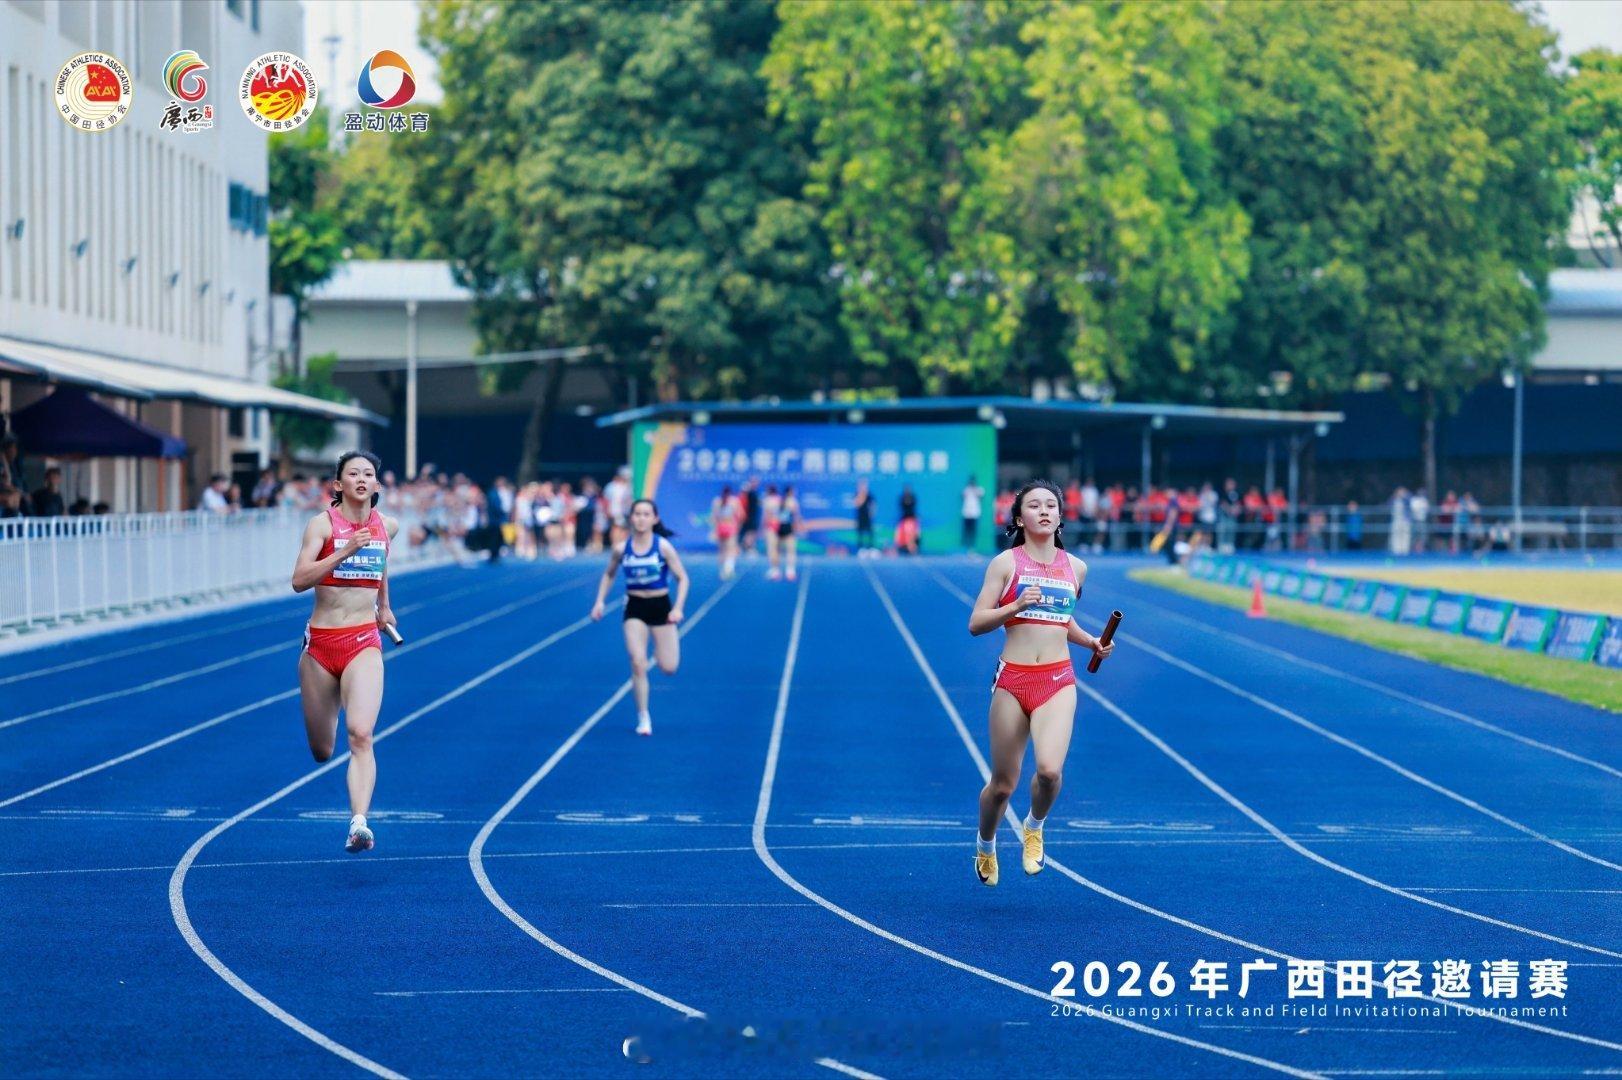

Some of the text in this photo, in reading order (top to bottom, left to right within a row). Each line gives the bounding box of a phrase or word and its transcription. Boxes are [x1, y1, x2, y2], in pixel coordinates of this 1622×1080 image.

[678, 448, 949, 473] 2026年广西田
[342, 555, 382, 565] 家集训二队
